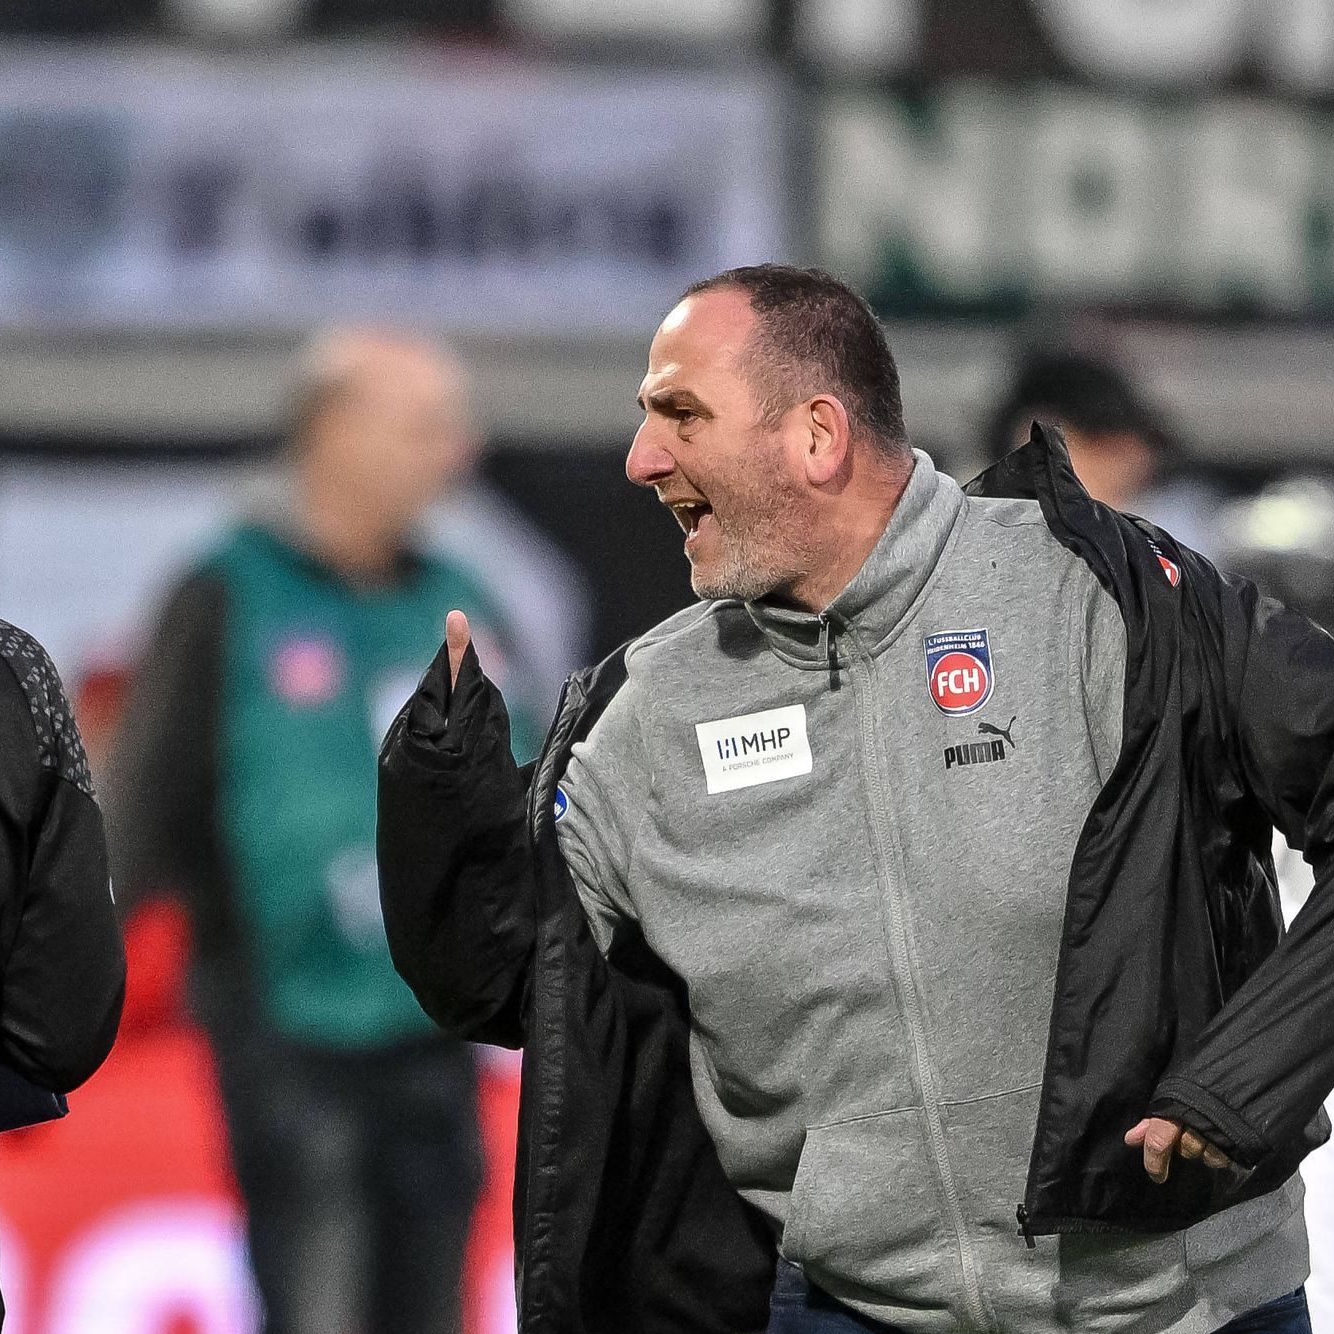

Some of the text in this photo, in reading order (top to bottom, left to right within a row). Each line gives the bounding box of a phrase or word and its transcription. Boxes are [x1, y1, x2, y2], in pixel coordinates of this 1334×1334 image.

[937, 668, 980, 697] FCH
[741, 727, 791, 755] MHP
[944, 739, 1006, 770] PUMA
[762, 753, 794, 766] COMPANY
